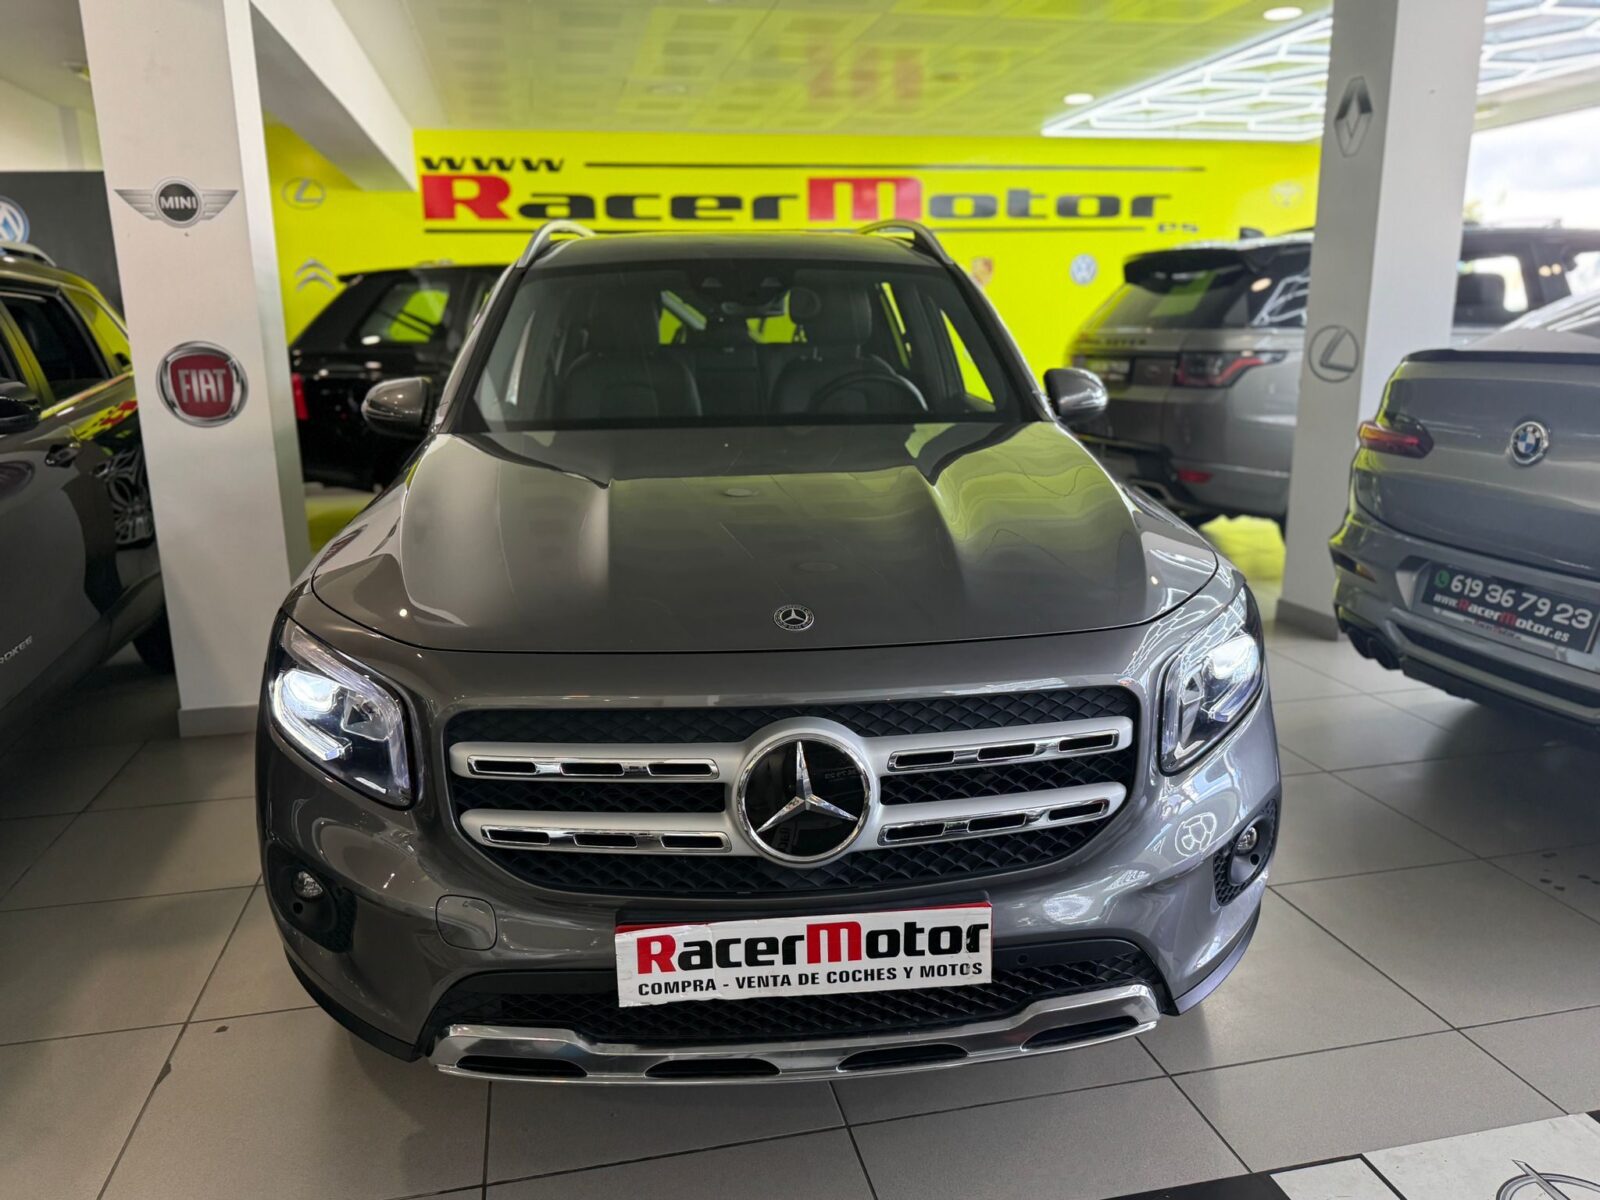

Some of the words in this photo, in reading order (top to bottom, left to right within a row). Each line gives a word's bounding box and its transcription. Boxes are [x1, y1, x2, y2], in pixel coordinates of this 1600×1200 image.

[160, 196, 197, 210] MINI
[421, 173, 1172, 221] RacerMotor
[178, 368, 226, 403] FIAT
[1450, 574, 1484, 597] 619
[1485, 584, 1516, 608] 36
[1518, 592, 1551, 617] 79
[1552, 604, 1593, 629] 23
[636, 921, 989, 975] RacerMotor
[638, 978, 717, 996] COMPRA
[735, 974, 792, 990] VENTA
[798, 972, 820, 986] DE
[826, 967, 897, 984] COCHES
[903, 966, 914, 979] Y
[920, 962, 983, 978] MOTOS
